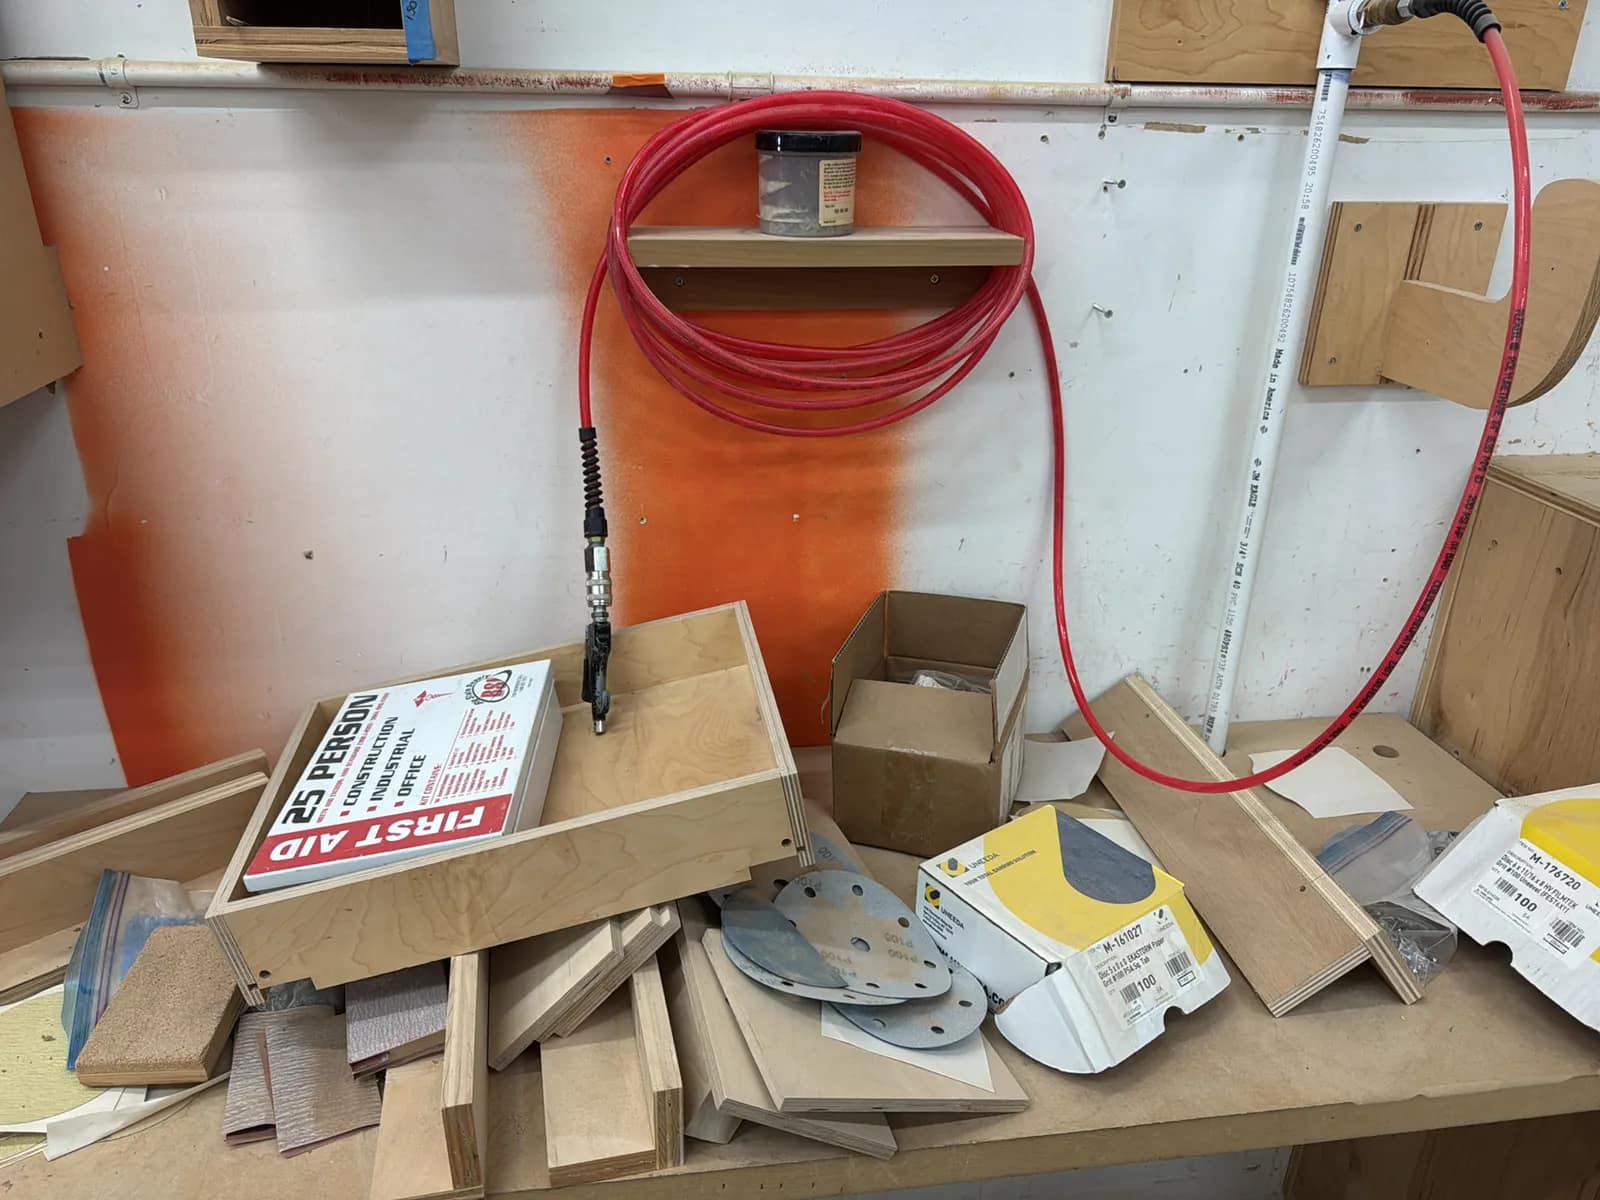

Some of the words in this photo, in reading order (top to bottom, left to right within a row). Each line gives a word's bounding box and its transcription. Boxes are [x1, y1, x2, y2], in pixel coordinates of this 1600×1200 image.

[1271, 347, 1283, 369] Made
[1269, 373, 1279, 383] in
[1261, 386, 1275, 421] America
[282, 789, 325, 825] 25
[307, 693, 379, 782] PERSON
[343, 715, 399, 806] CONSTRUCTION
[369, 727, 416, 802] INDUSTRIAL
[397, 754, 427, 797] OFFICE
[354, 805, 486, 849] FIRST
[269, 830, 350, 862] AID
[968, 853, 1000, 869] UNEEDA
[1529, 852, 1582, 891] M-176720
[1514, 892, 1538, 912] 100
[1551, 888, 1578, 909] FILMTEK
[940, 906, 965, 929] UNEEDA
[1102, 924, 1143, 954] M-161027
[1139, 956, 1150, 965] Tab
[1137, 974, 1157, 992] 100
